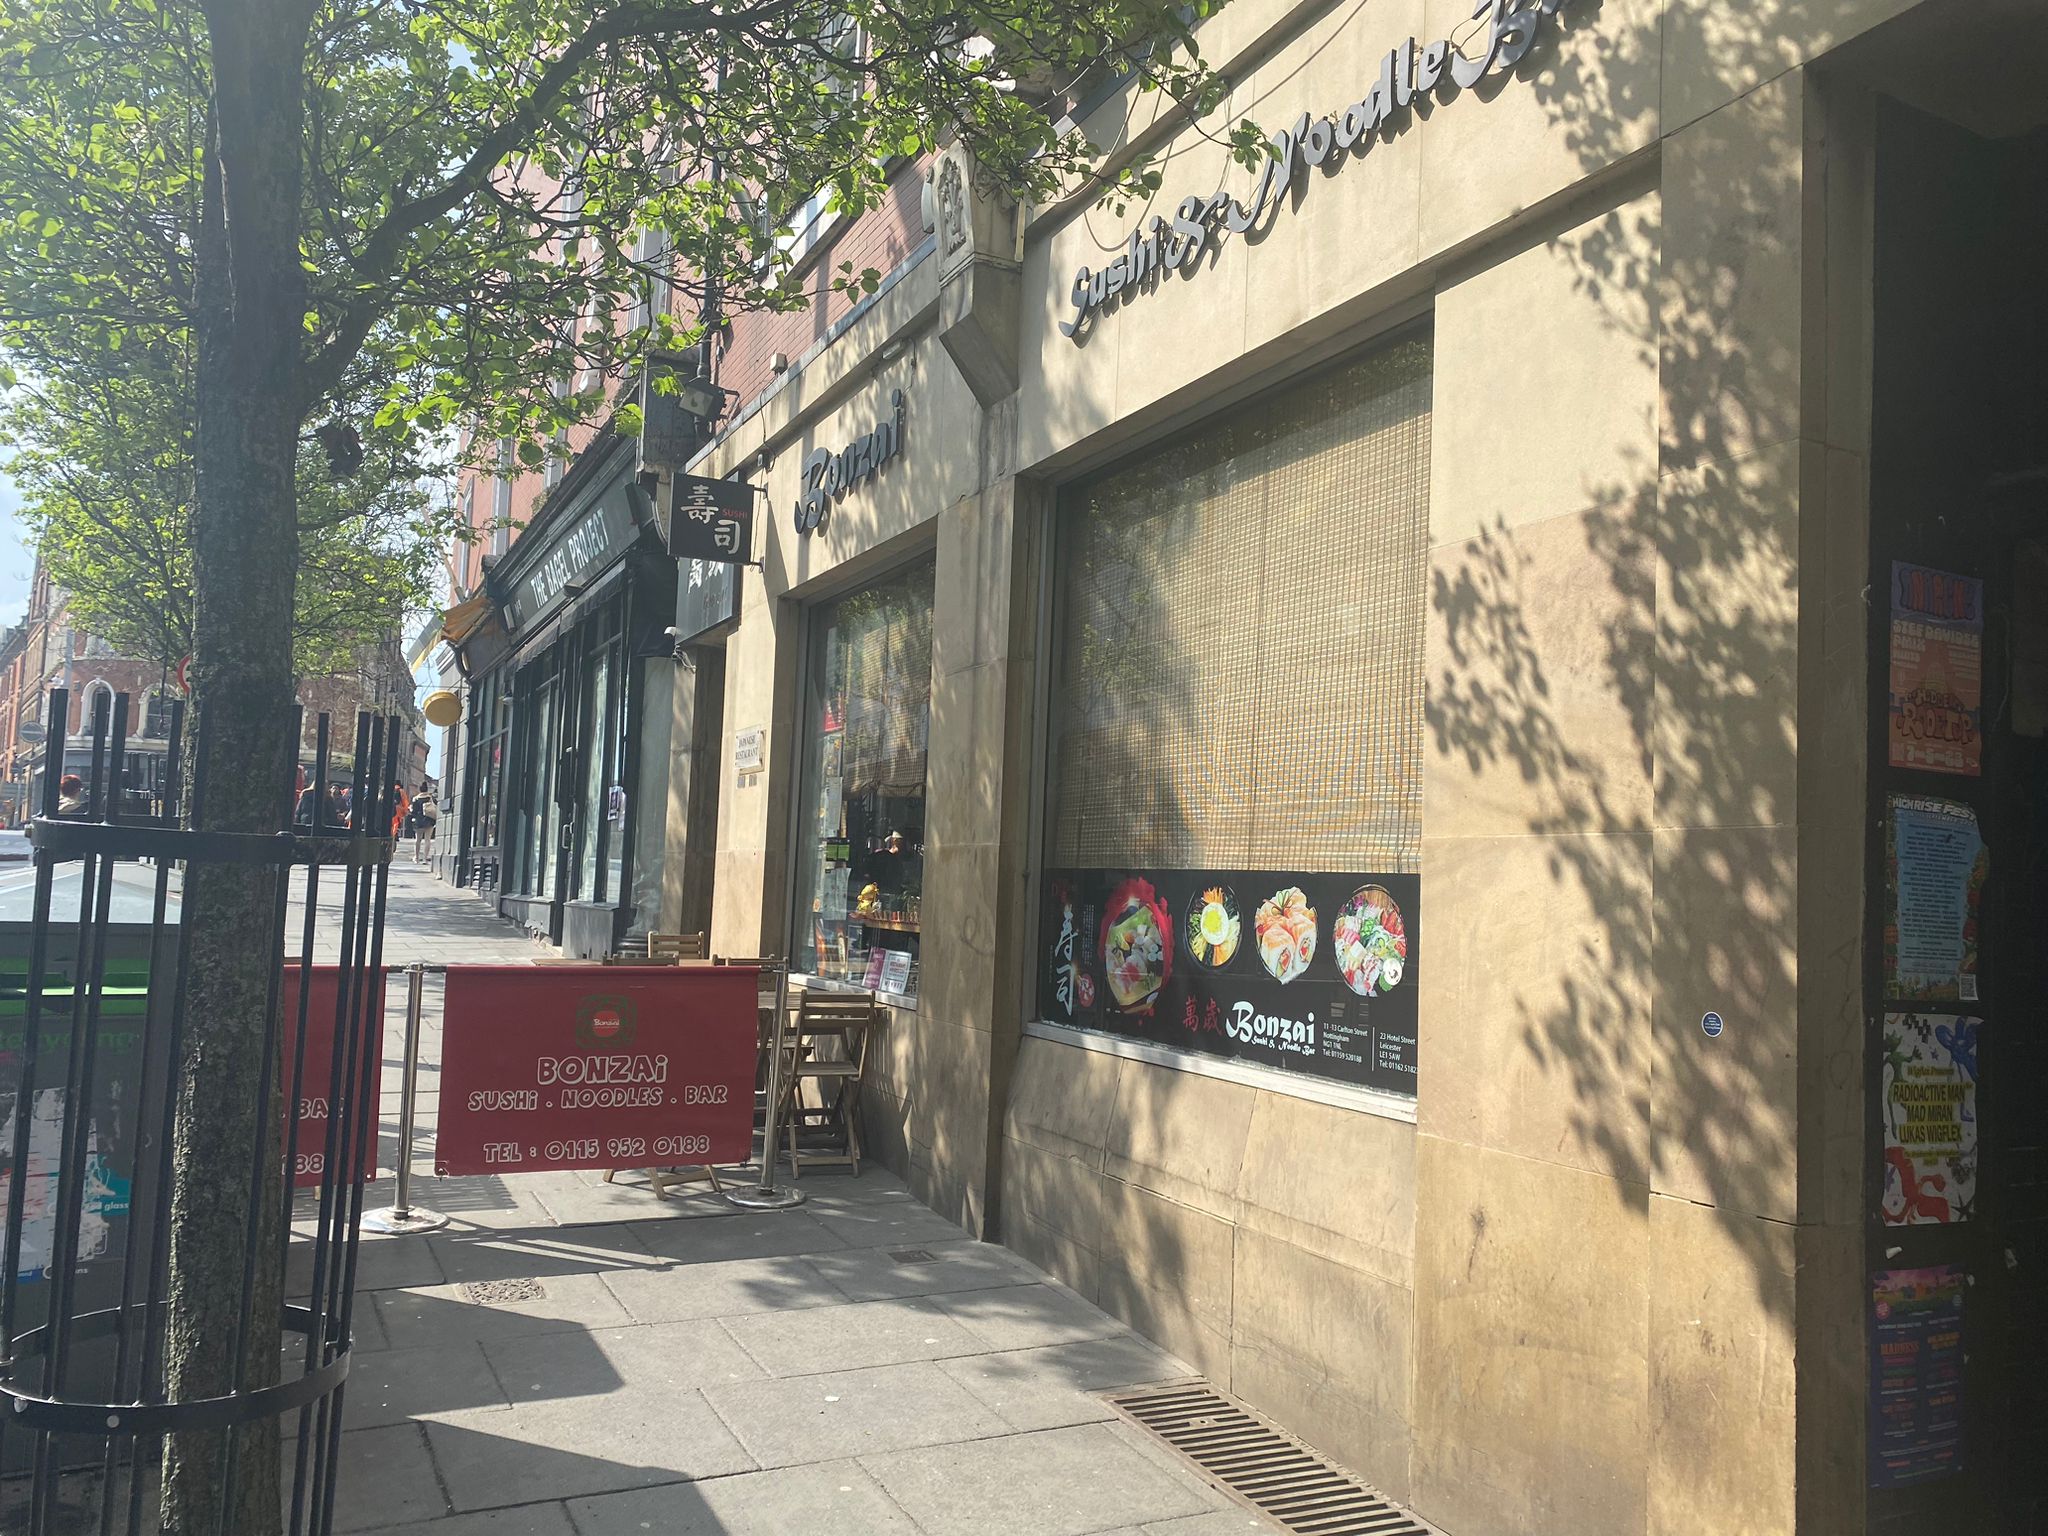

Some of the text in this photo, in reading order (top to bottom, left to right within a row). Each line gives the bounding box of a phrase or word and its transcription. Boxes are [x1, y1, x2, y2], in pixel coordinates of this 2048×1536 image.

[1058, 215, 1163, 337] Sushi
[1164, 192, 1229, 269] &
[1227, 36, 1449, 233] Noodle
[794, 388, 903, 534] Bonzai
[721, 507, 748, 520] SUSHI
[530, 507, 610, 608] THE BAGEL PROJECT
[593, 1018, 620, 1026] Bonzai
[1226, 1000, 1316, 1045] Bonzai
[1337, 1025, 1354, 1034] Carlton
[1354, 1028, 1368, 1037] Street
[1251, 1035, 1316, 1056] Sushi & Noodle Bar
[1323, 1031, 1350, 1042] Nottingham
[1379, 1032, 1416, 1046] 23 Hotel Street
[1379, 1041, 1402, 1052] Leicester
[560, 1086, 663, 1109] NOODLES
[685, 1084, 728, 1106] BAR
[1893, 1083, 1946, 1103] RADIOACTIVE
[1947, 1084, 1965, 1103] MAN
[1906, 1105, 1953, 1123] MAD MIRAN
[1899, 1124, 1962, 1143] LUKAS WIGFLEX
[483, 1142, 522, 1163] TEL
[544, 1137, 599, 1160] 0115
[607, 1136, 645, 1157] 952
[652, 1135, 710, 1156] 0188
